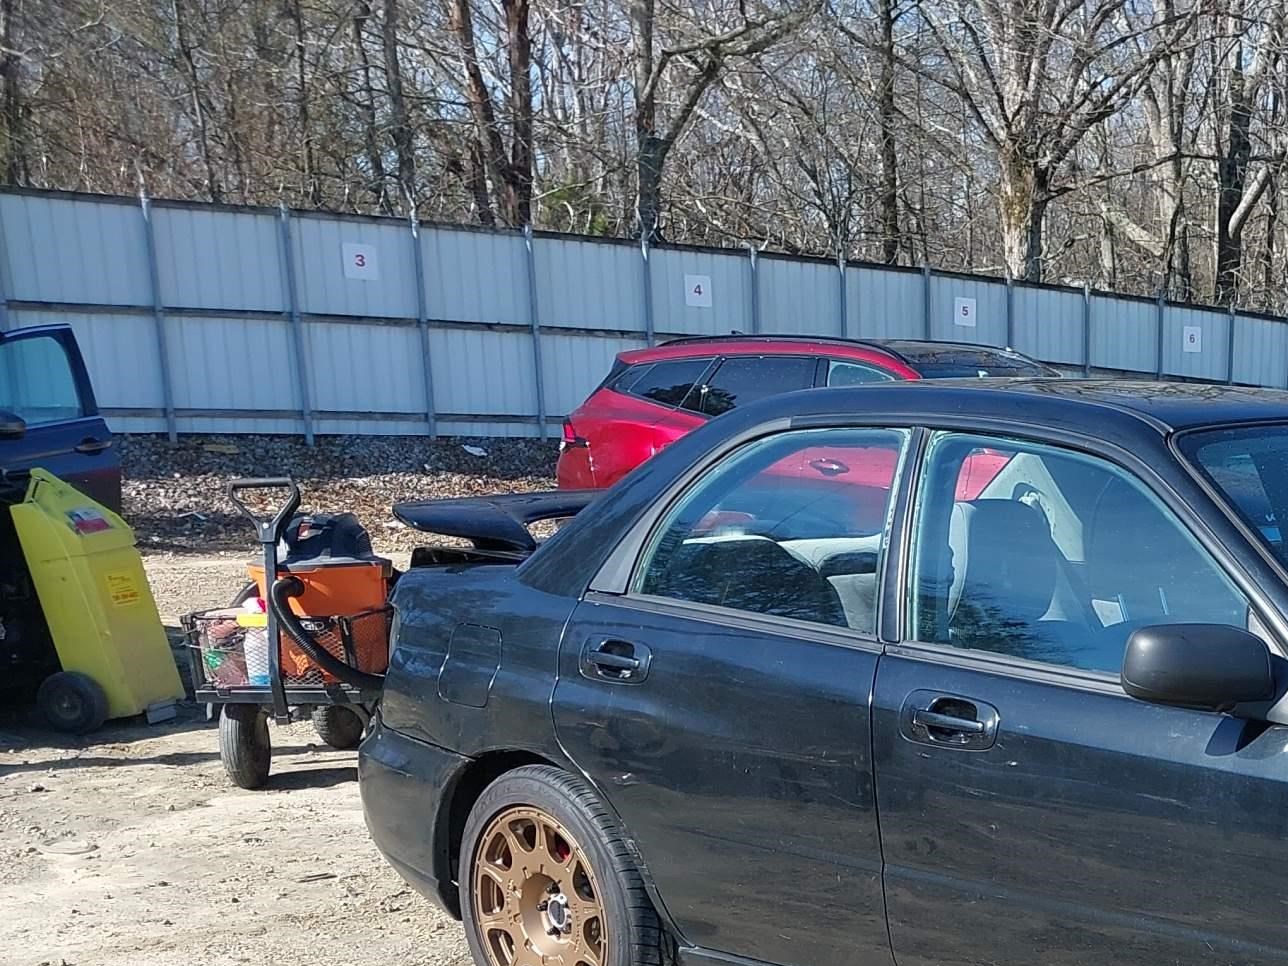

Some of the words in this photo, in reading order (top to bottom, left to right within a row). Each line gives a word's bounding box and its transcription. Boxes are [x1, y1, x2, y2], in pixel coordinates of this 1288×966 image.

[354, 254, 366, 267] 3
[693, 284, 703, 296] 4
[962, 305, 969, 316] 5
[1188, 333, 1196, 344] 6
